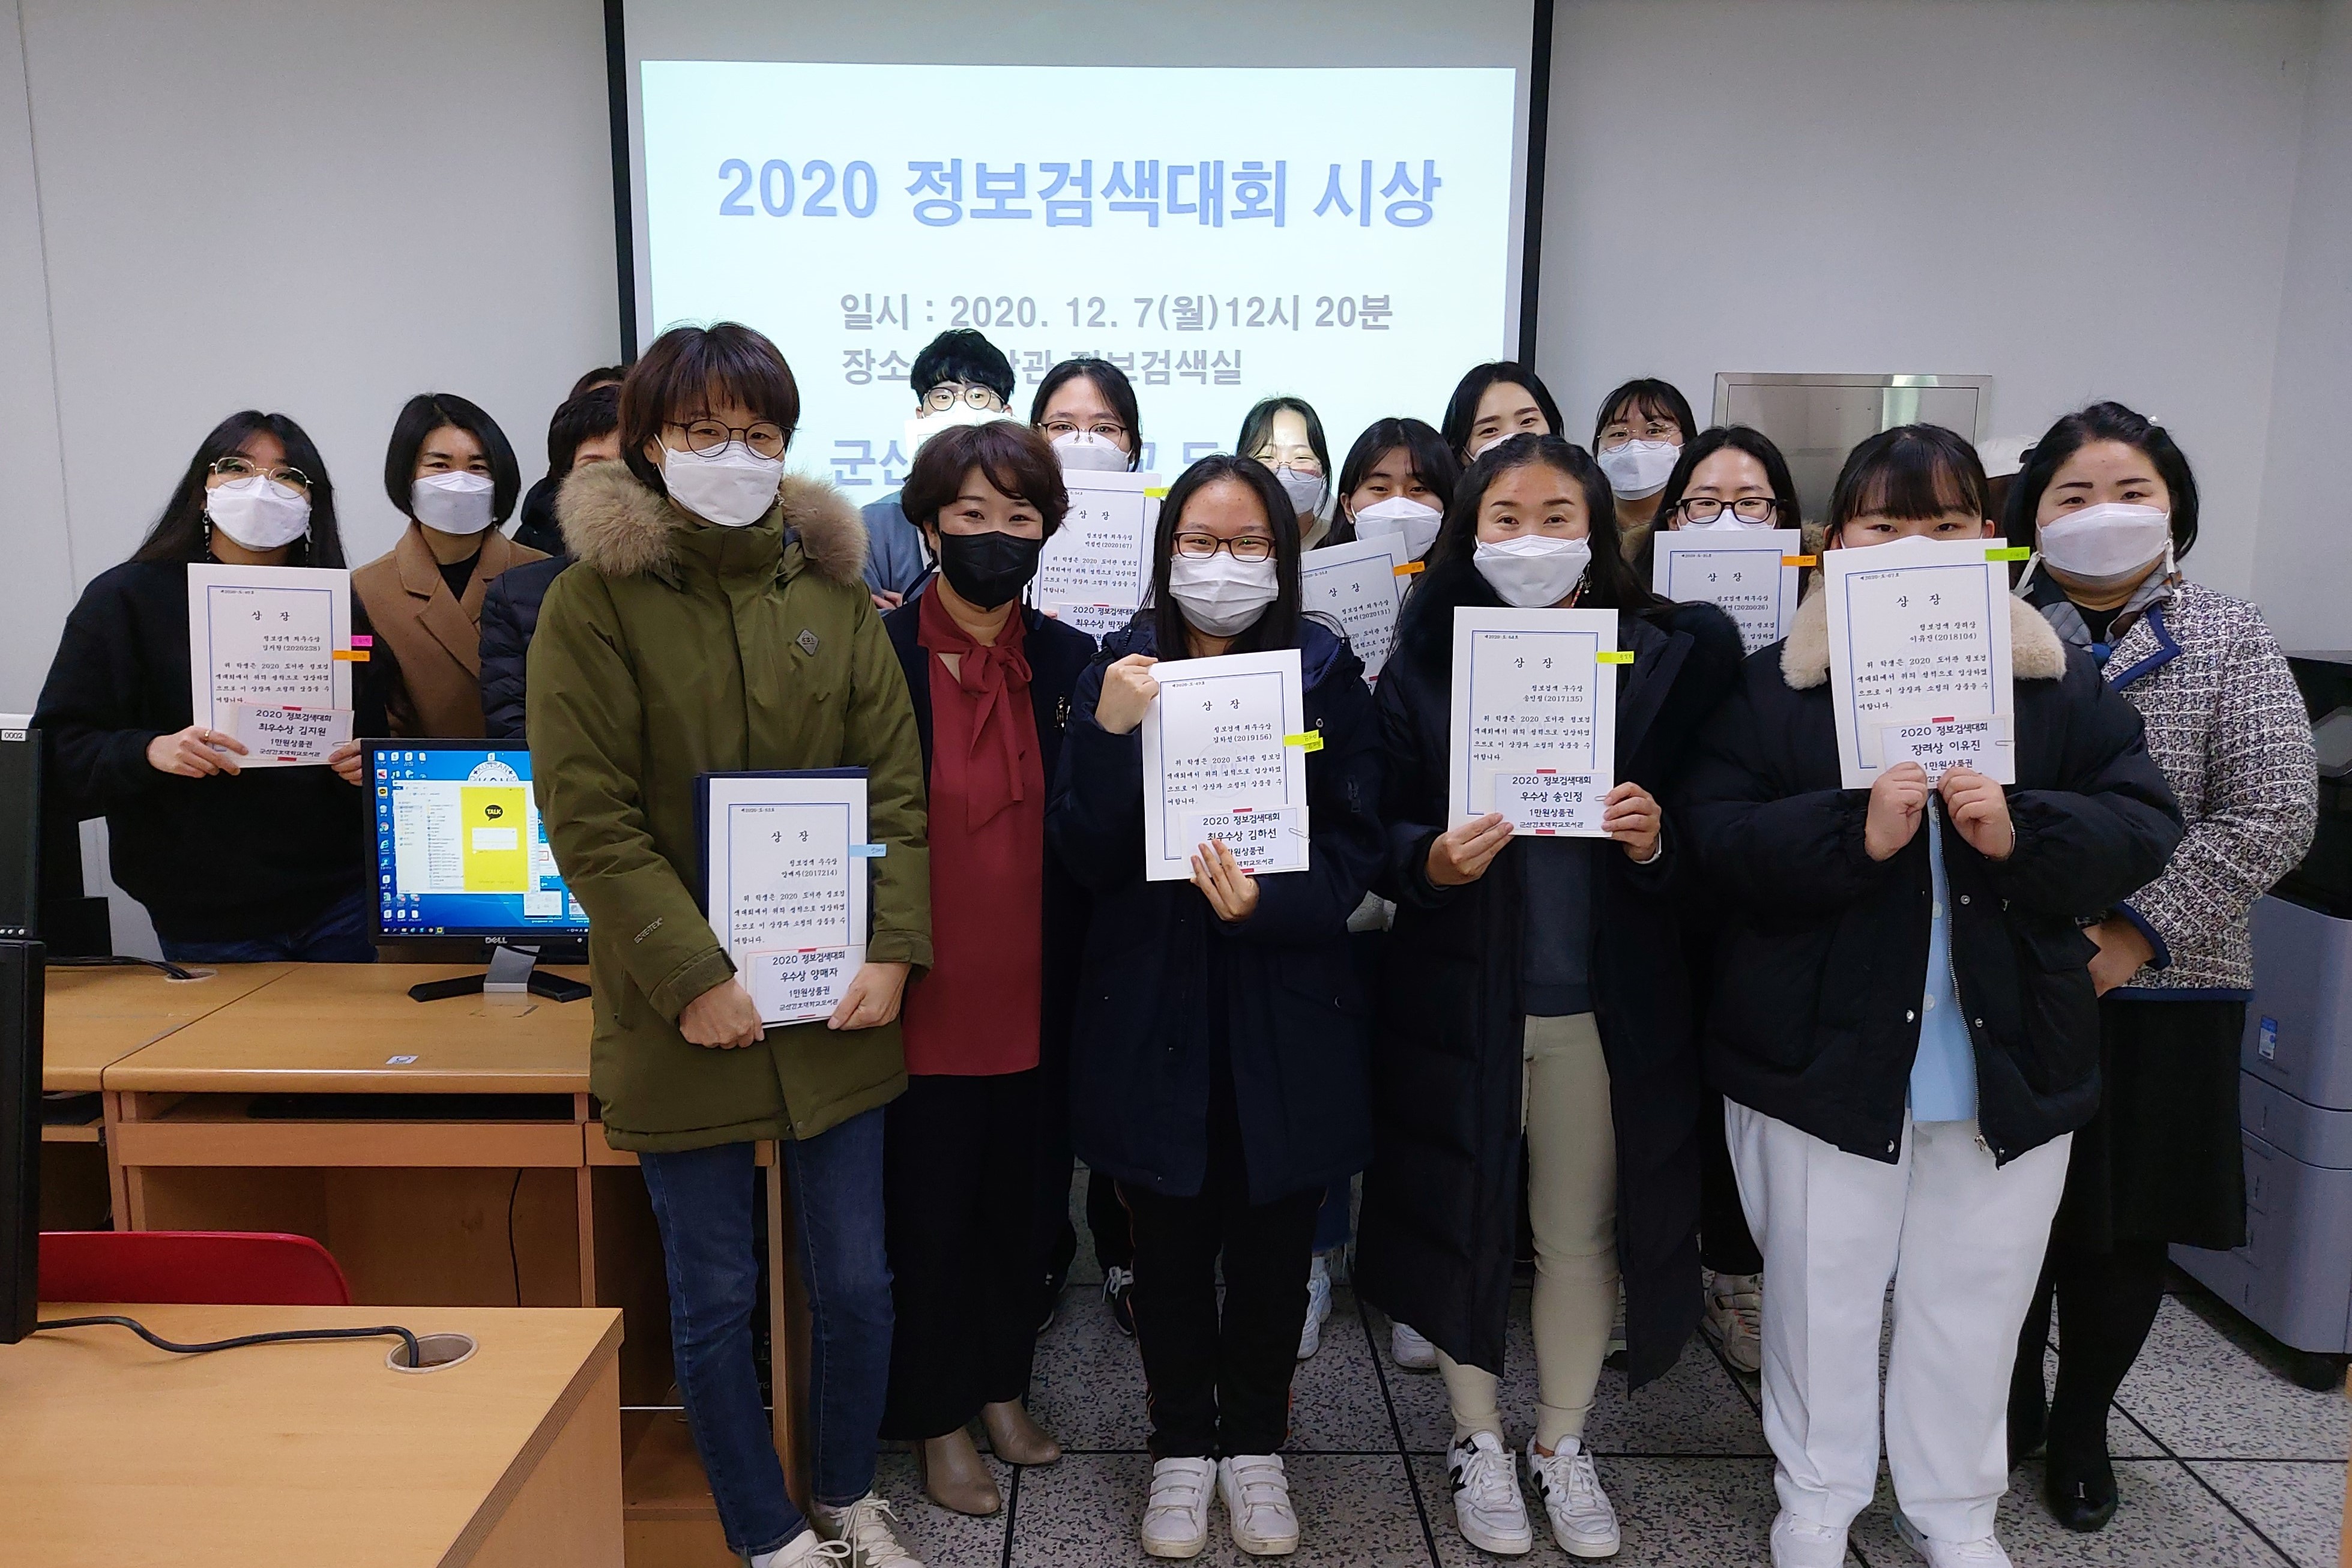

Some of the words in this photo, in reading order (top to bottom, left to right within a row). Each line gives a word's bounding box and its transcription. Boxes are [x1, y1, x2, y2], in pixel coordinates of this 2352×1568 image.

[719, 158, 878, 218] 2020
[905, 158, 1286, 228] 정보검색대회
[1313, 160, 1441, 227] 시상
[840, 294, 908, 330] 일시
[950, 296, 1048, 327] 2020.
[1066, 297, 1117, 327] 12.
[1315, 294, 1392, 330] 20분
[842, 349, 911, 385] 장소
[1076, 619, 1105, 629] 최우수상
[256, 710, 282, 718] 2020
[286, 711, 331, 722] 정보검색대회
[259, 723, 294, 734] 최우수상
[299, 726, 326, 736] 김지원
[1901, 728, 1931, 737] 2020
[1937, 723, 1987, 736] 정보검색대회
[1911, 743, 1944, 756] 장려상
[1949, 740, 1980, 751] 이유진
[1543, 776, 1591, 786] 정보검색대회
[1521, 792, 1548, 802] 우수상
[1552, 792, 1582, 802] 송인정
[1234, 813, 1279, 825] 정보검색대회
[1207, 831, 1243, 842] 최우수상
[1249, 828, 1276, 840] 김하선
[773, 956, 797, 965] 2020
[801, 951, 845, 964] 정보검색대회
[780, 970, 806, 982] 우수상
[810, 968, 838, 980] 양매자
